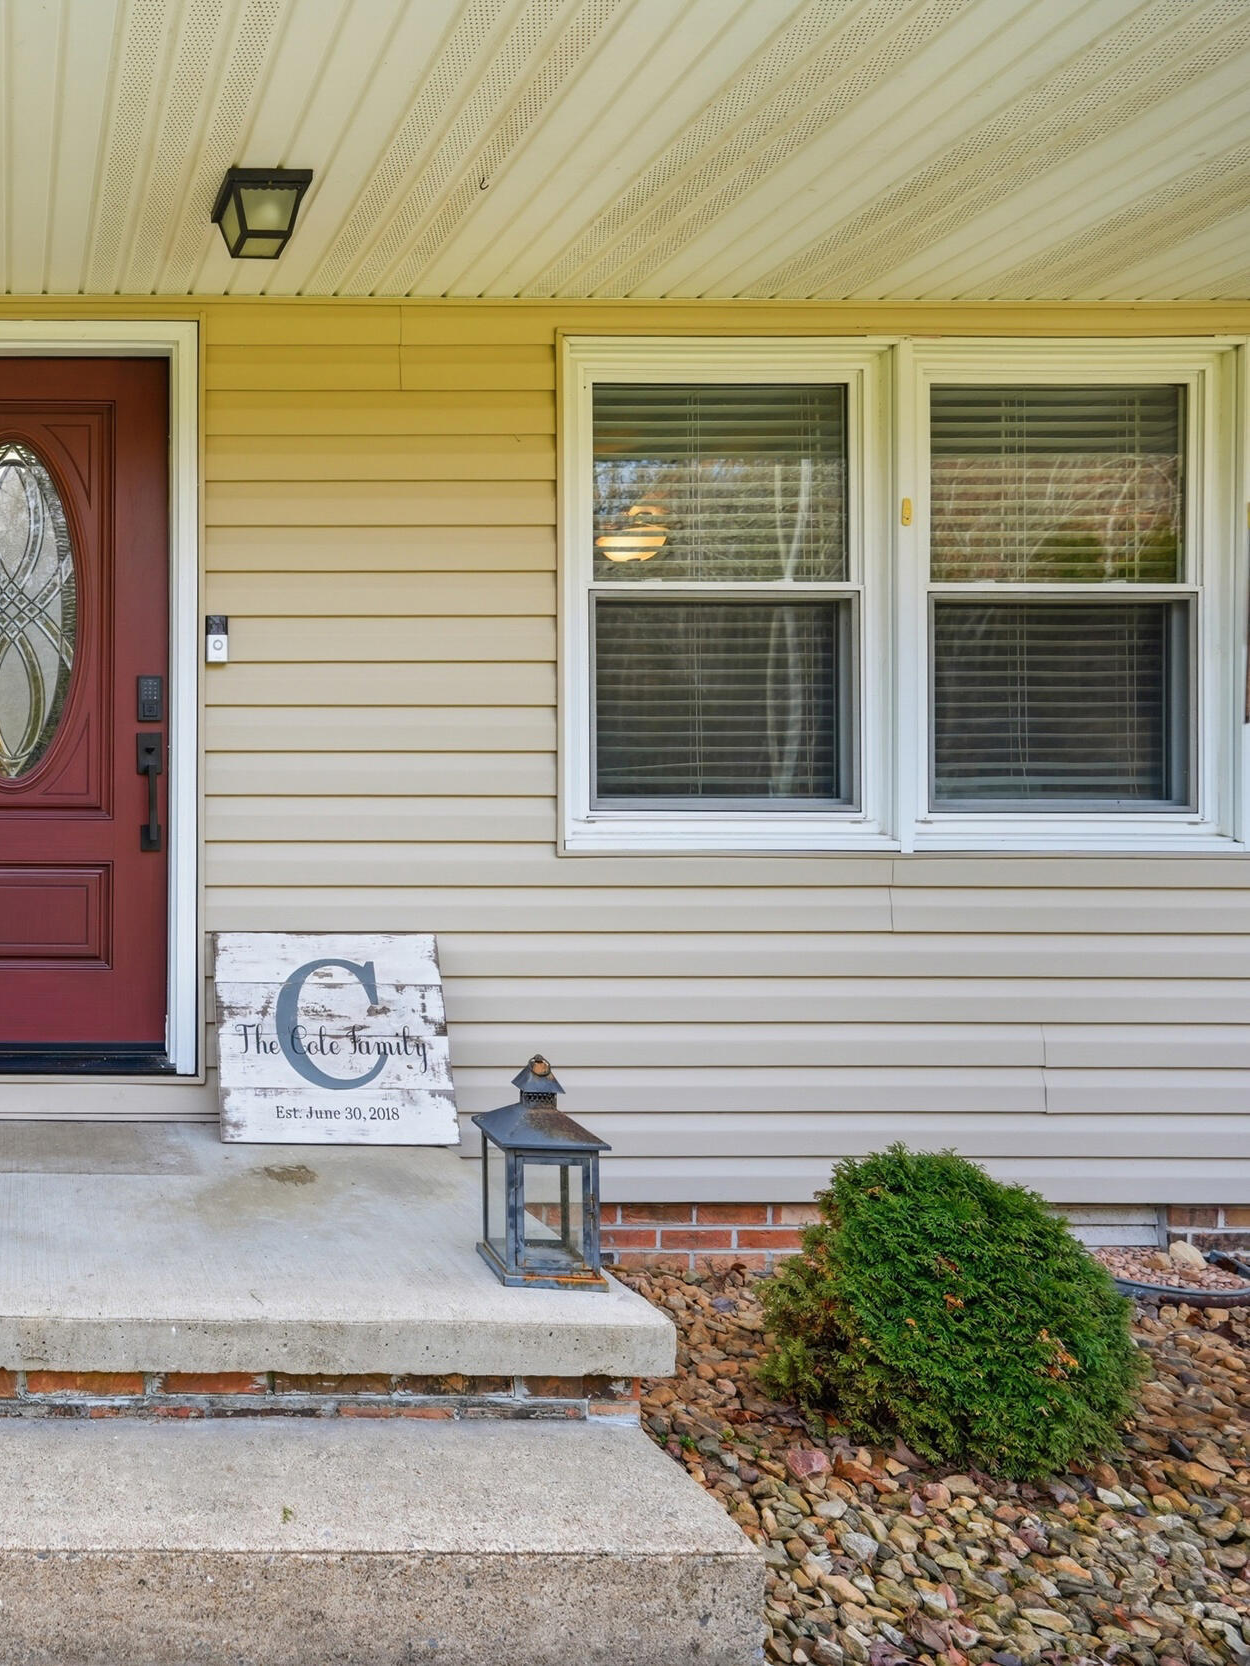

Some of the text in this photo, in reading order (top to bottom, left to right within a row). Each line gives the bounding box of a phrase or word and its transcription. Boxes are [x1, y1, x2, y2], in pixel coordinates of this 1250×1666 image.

[235, 1023, 427, 1073] The Cole Family
[275, 958, 388, 1091] C
[275, 1105, 400, 1121] Est. June 30, 2018
